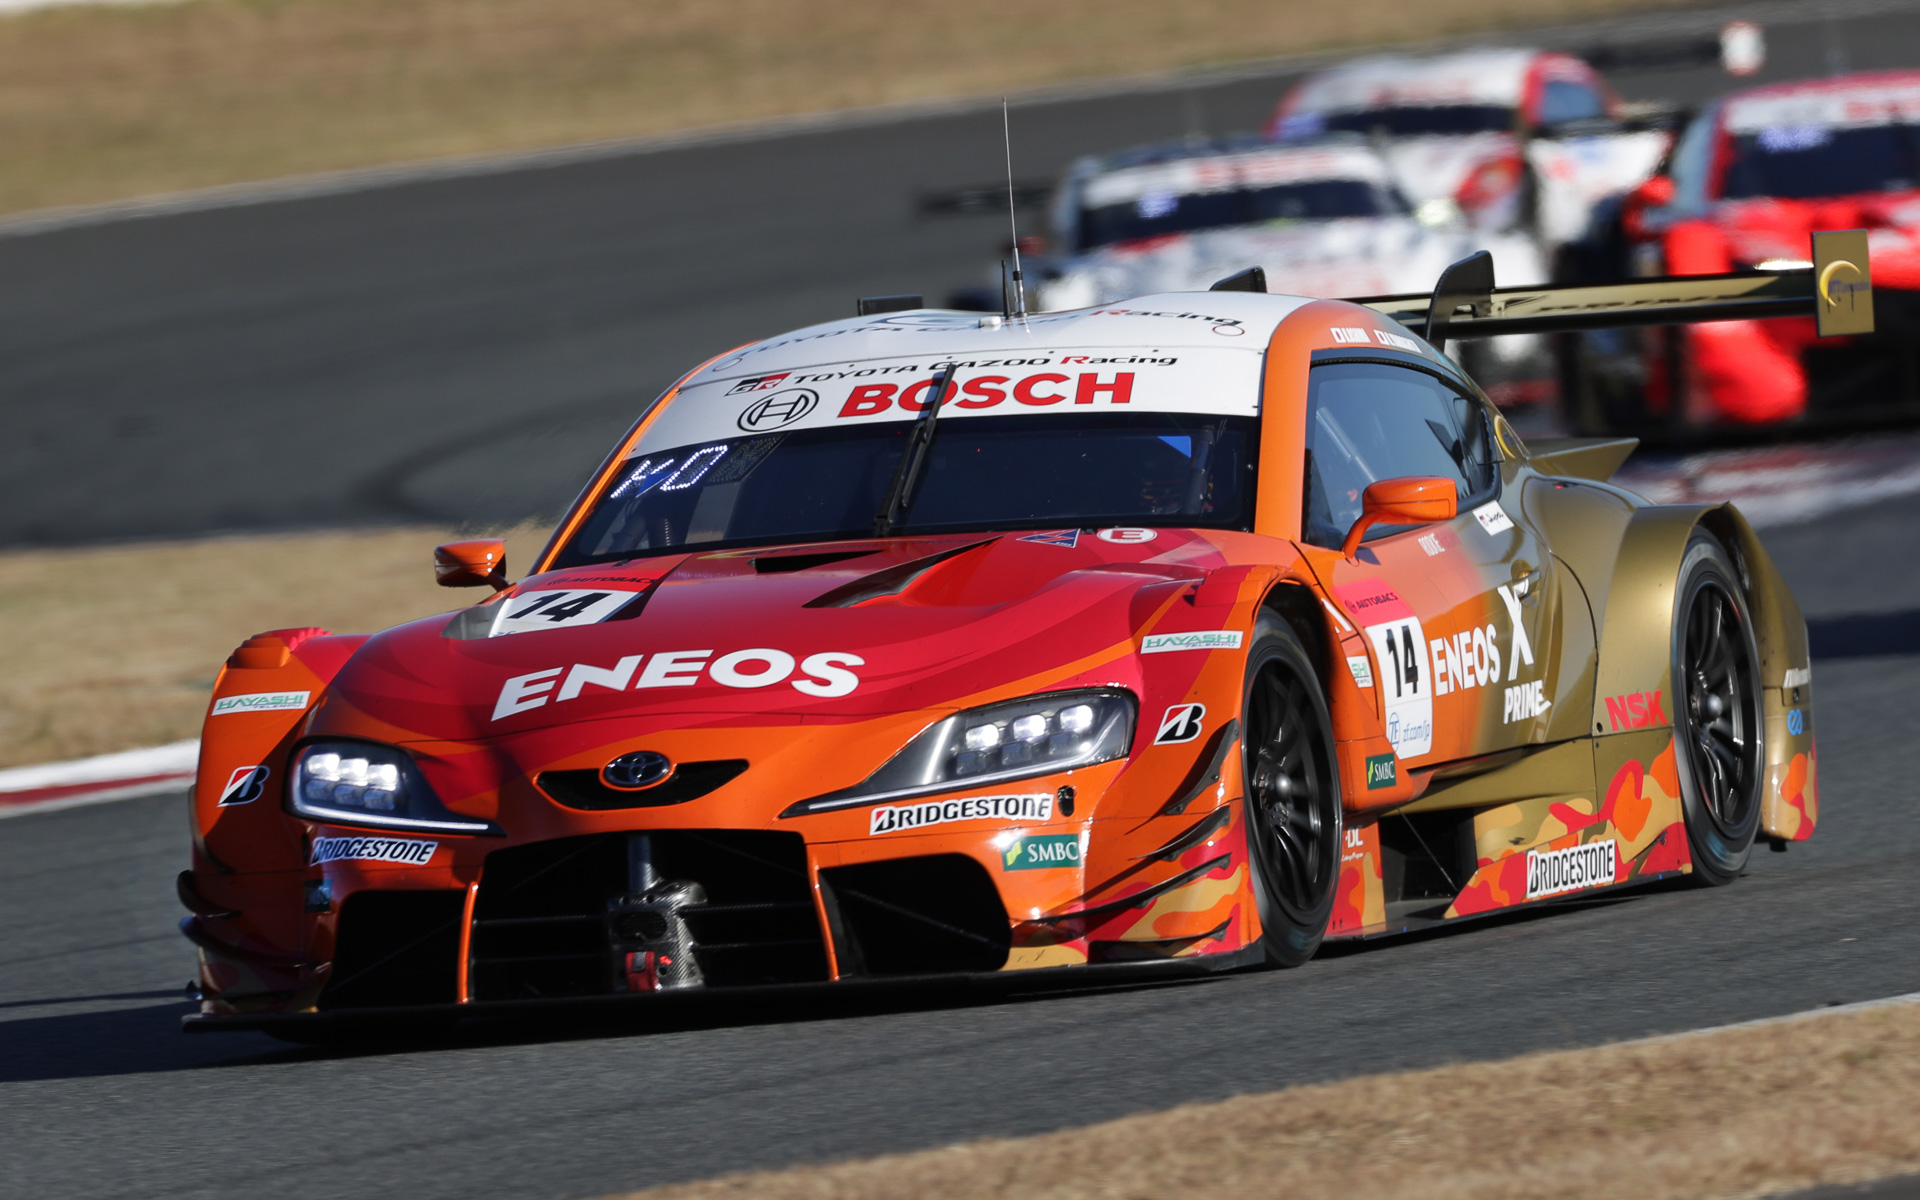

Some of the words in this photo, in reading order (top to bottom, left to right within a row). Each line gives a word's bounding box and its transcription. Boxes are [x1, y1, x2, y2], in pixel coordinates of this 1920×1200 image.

[793, 364, 912, 385] TOYOTA
[927, 357, 1051, 371] GAZOO
[1060, 355, 1178, 367] Racing
[836, 372, 1134, 418] BOSCH
[506, 591, 612, 622] 14
[1356, 592, 1398, 610] AUTOBACS
[1146, 634, 1237, 648] HAYASHI
[1386, 625, 1418, 698] 14
[1430, 624, 1501, 697] ENEOS
[490, 648, 865, 722] ENEOS
[216, 695, 304, 710] HAYASHI
[1504, 680, 1552, 724] PRIME
[1605, 691, 1668, 731] NSK
[1374, 761, 1395, 782] SMBC
[873, 797, 1051, 833] BRIDGESTONE
[311, 838, 435, 865] BRIDGESTONE
[1027, 841, 1078, 863] SMBC
[1528, 842, 1614, 894] BRIDGESTONE
